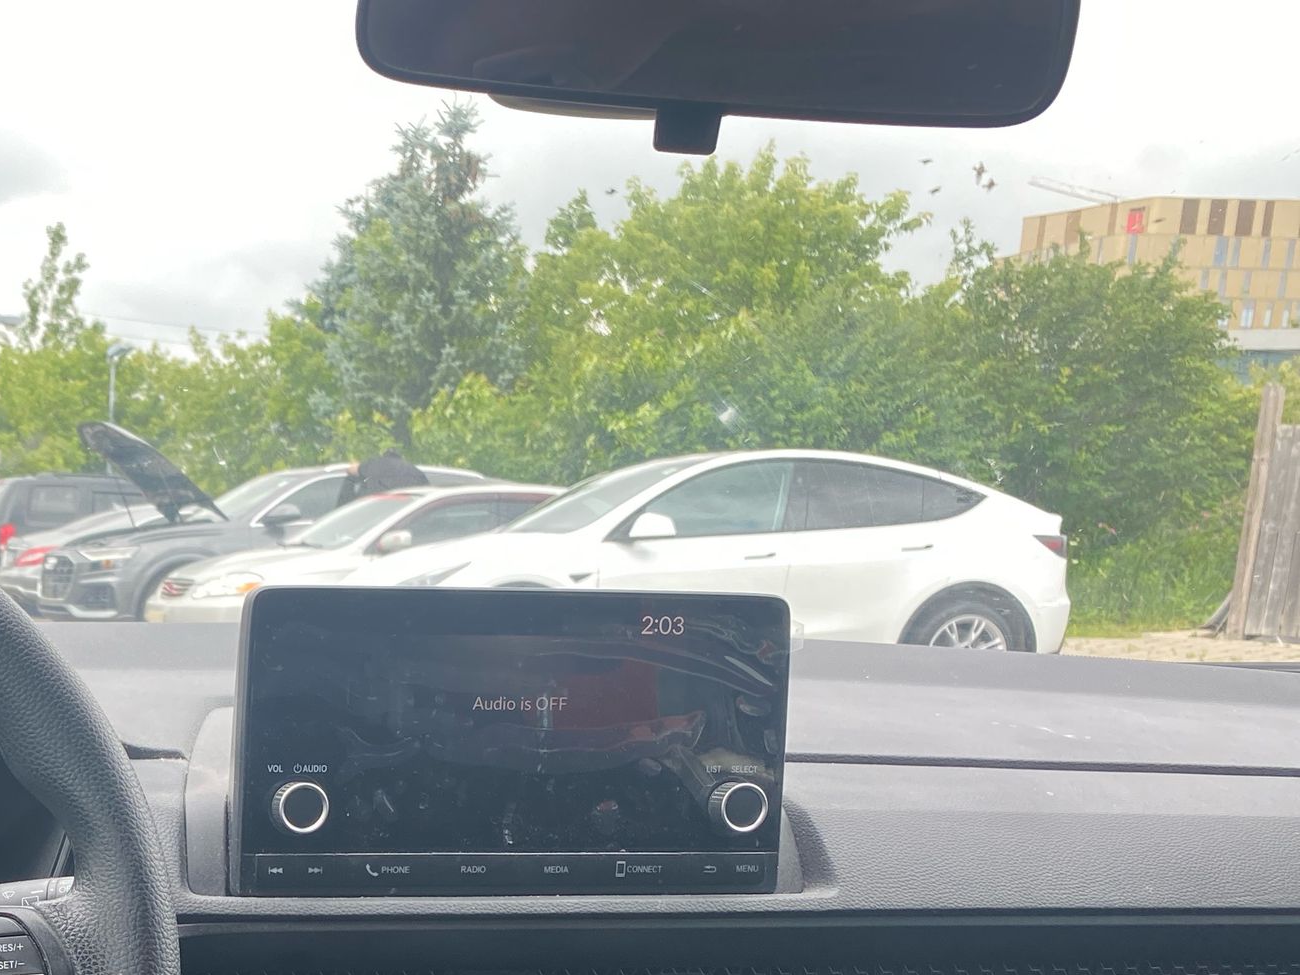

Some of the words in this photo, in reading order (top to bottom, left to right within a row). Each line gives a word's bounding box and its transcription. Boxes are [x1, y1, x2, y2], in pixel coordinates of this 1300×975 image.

[641, 616, 685, 636] 2:03
[472, 696, 516, 711] Audio
[520, 697, 532, 711] is
[536, 697, 568, 711] OFF
[267, 764, 284, 773] VOL
[303, 764, 328, 773] AUDIO
[706, 765, 722, 774] LIST
[731, 765, 758, 774] SELECT
[381, 865, 411, 874] PHONE
[460, 865, 486, 874] RADIO
[543, 865, 569, 874] MEDIA
[626, 865, 662, 874] CONNECT
[735, 864, 759, 873] MENU
